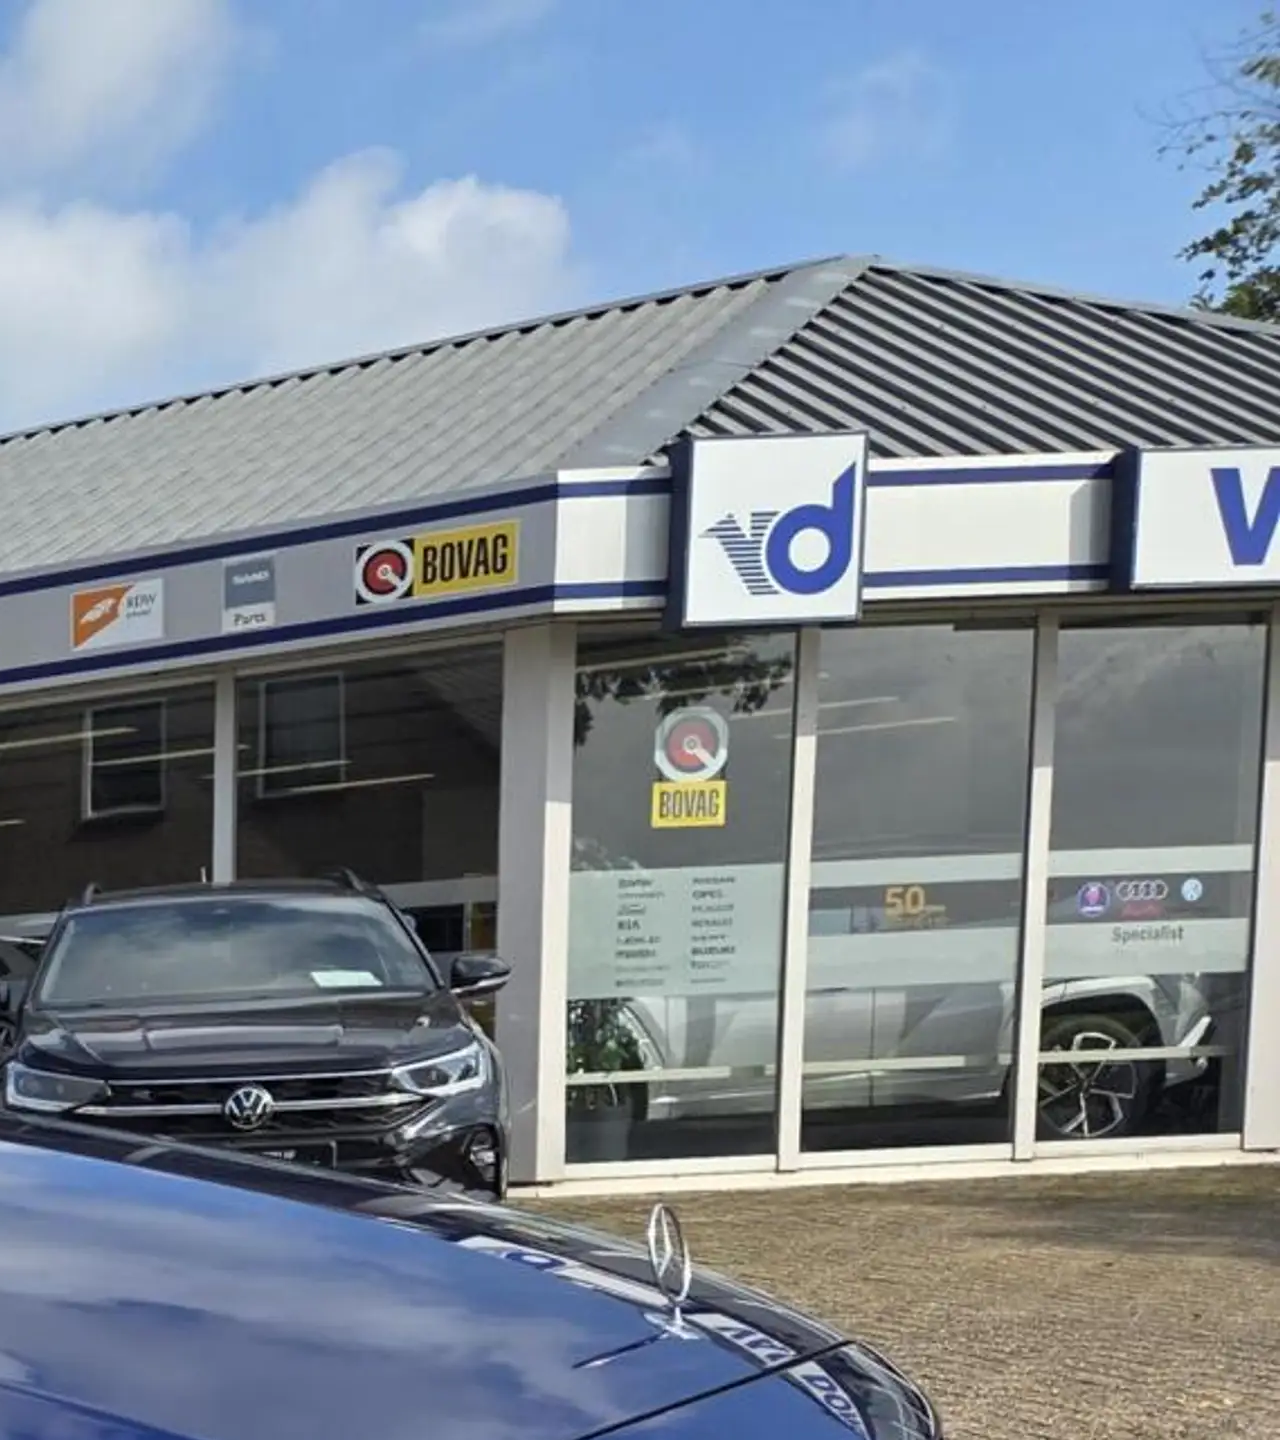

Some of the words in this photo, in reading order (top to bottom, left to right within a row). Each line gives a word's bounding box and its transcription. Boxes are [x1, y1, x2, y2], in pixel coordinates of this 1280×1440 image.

[1210, 467, 1280, 566] V
[421, 533, 509, 585] BOVAG
[658, 788, 720, 819] BOVAG
[885, 885, 926, 915] 50
[1111, 926, 1184, 944] Specialist
